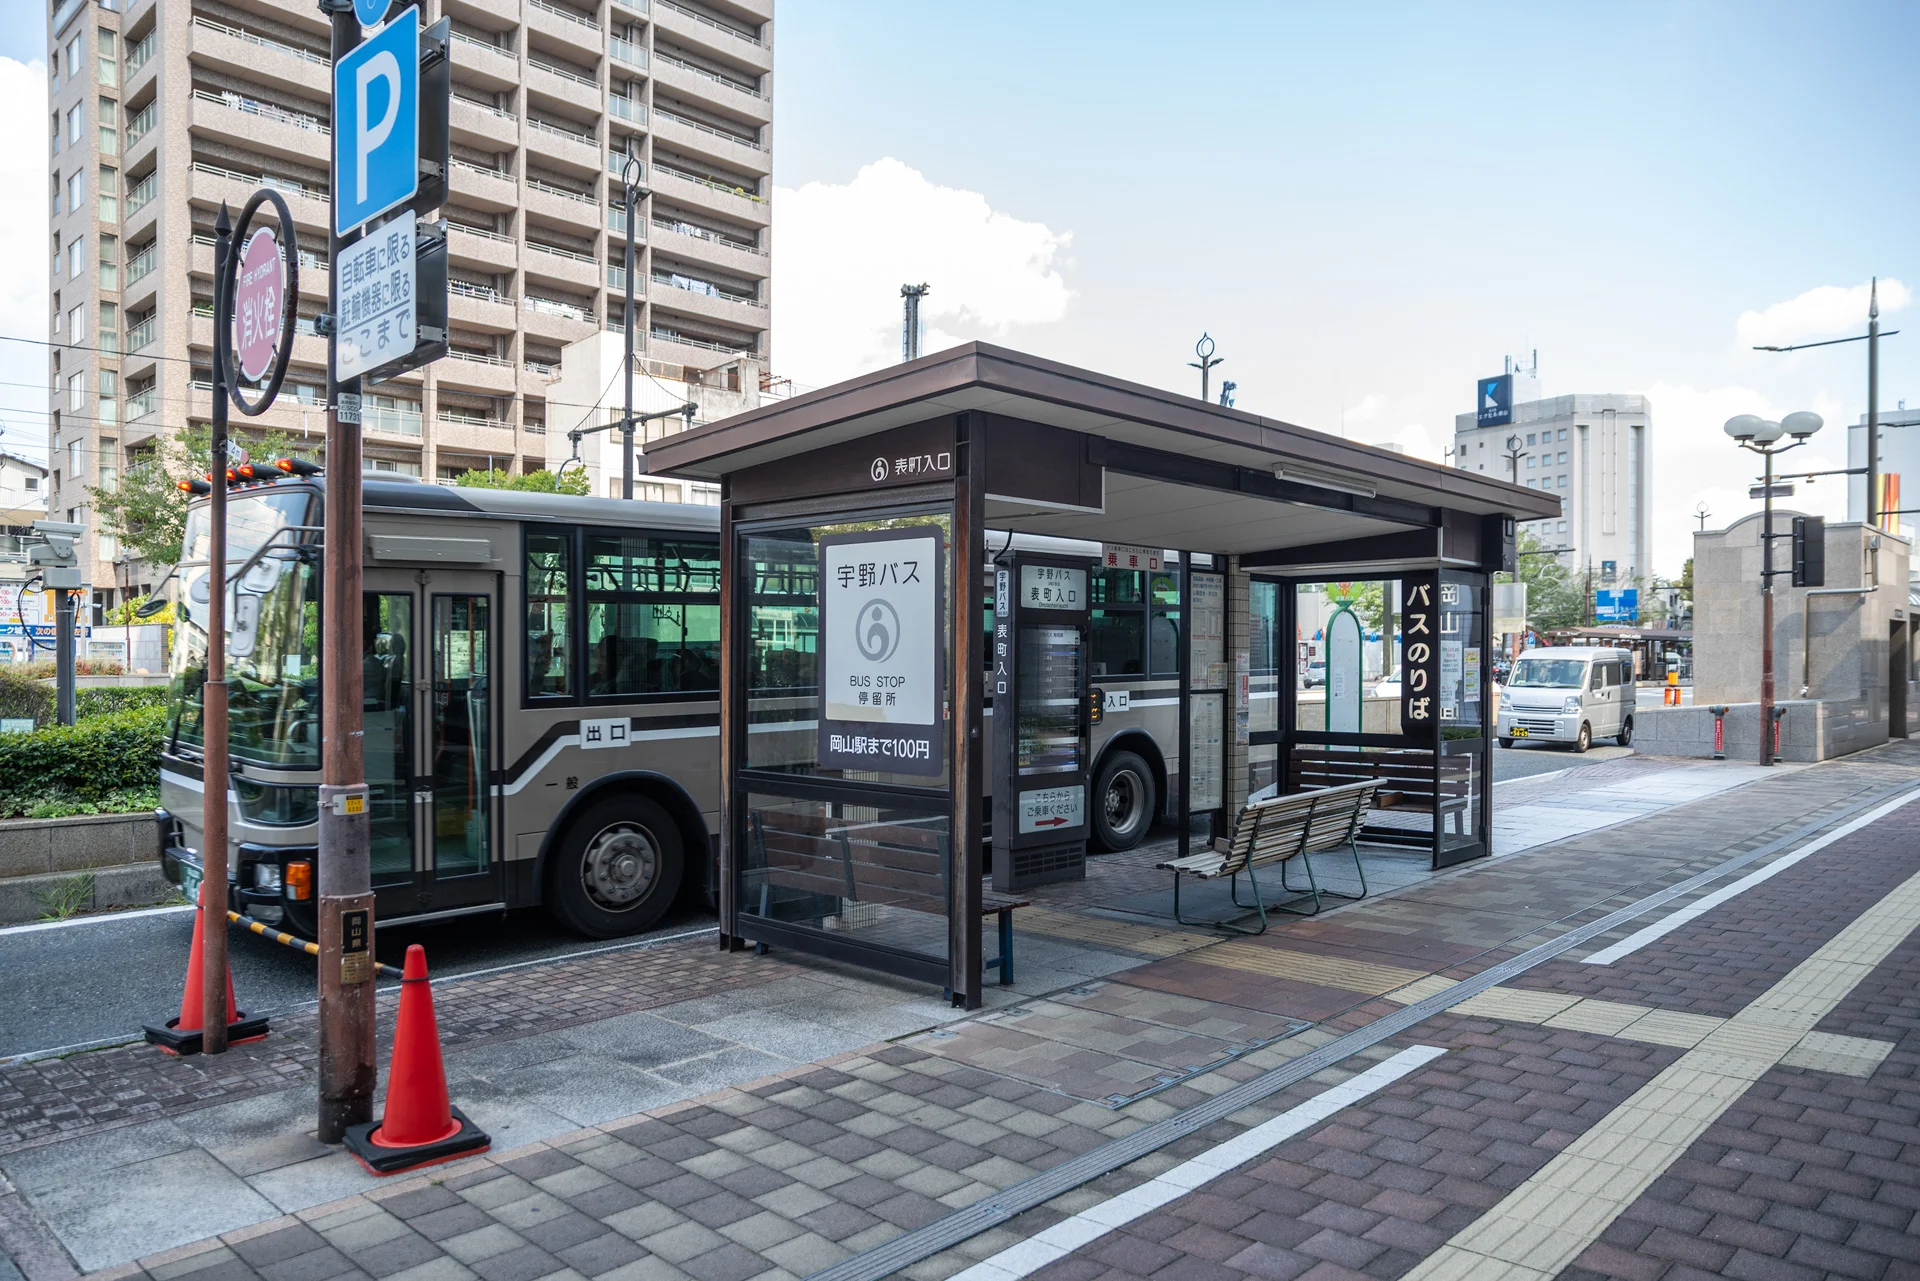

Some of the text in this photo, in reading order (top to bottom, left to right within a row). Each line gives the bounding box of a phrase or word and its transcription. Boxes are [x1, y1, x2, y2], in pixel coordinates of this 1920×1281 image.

[356, 50, 402, 205] P
[242, 256, 276, 288] FIRE HYDRANT
[342, 232, 410, 293] 自転車に限る
[340, 269, 411, 328] 駐輪機器に限る
[241, 285, 276, 349] 消火栓
[342, 308, 411, 365] ここまで
[340, 411, 360, 422] 11731
[894, 452, 951, 475] 表町入口
[1107, 552, 1158, 570] 乗車口
[837, 560, 920, 589] 宇野バス
[1037, 568, 1071, 581] 宇野バス
[998, 571, 1006, 611] 宇野バス
[1031, 586, 1076, 602] 表町入口
[996, 623, 1008, 694] 表町入口
[1406, 583, 1431, 720] バスのりば
[850, 675, 906, 688] BUS STOP
[858, 691, 897, 706] 停留所
[1107, 695, 1127, 708] 入口
[586, 724, 625, 742] 出口
[830, 734, 930, 760] 岡山駅まで100円
[544, 776, 579, 790] 一般
[1035, 790, 1070, 803] こちらから
[1027, 803, 1078, 817] ご乗車ください
